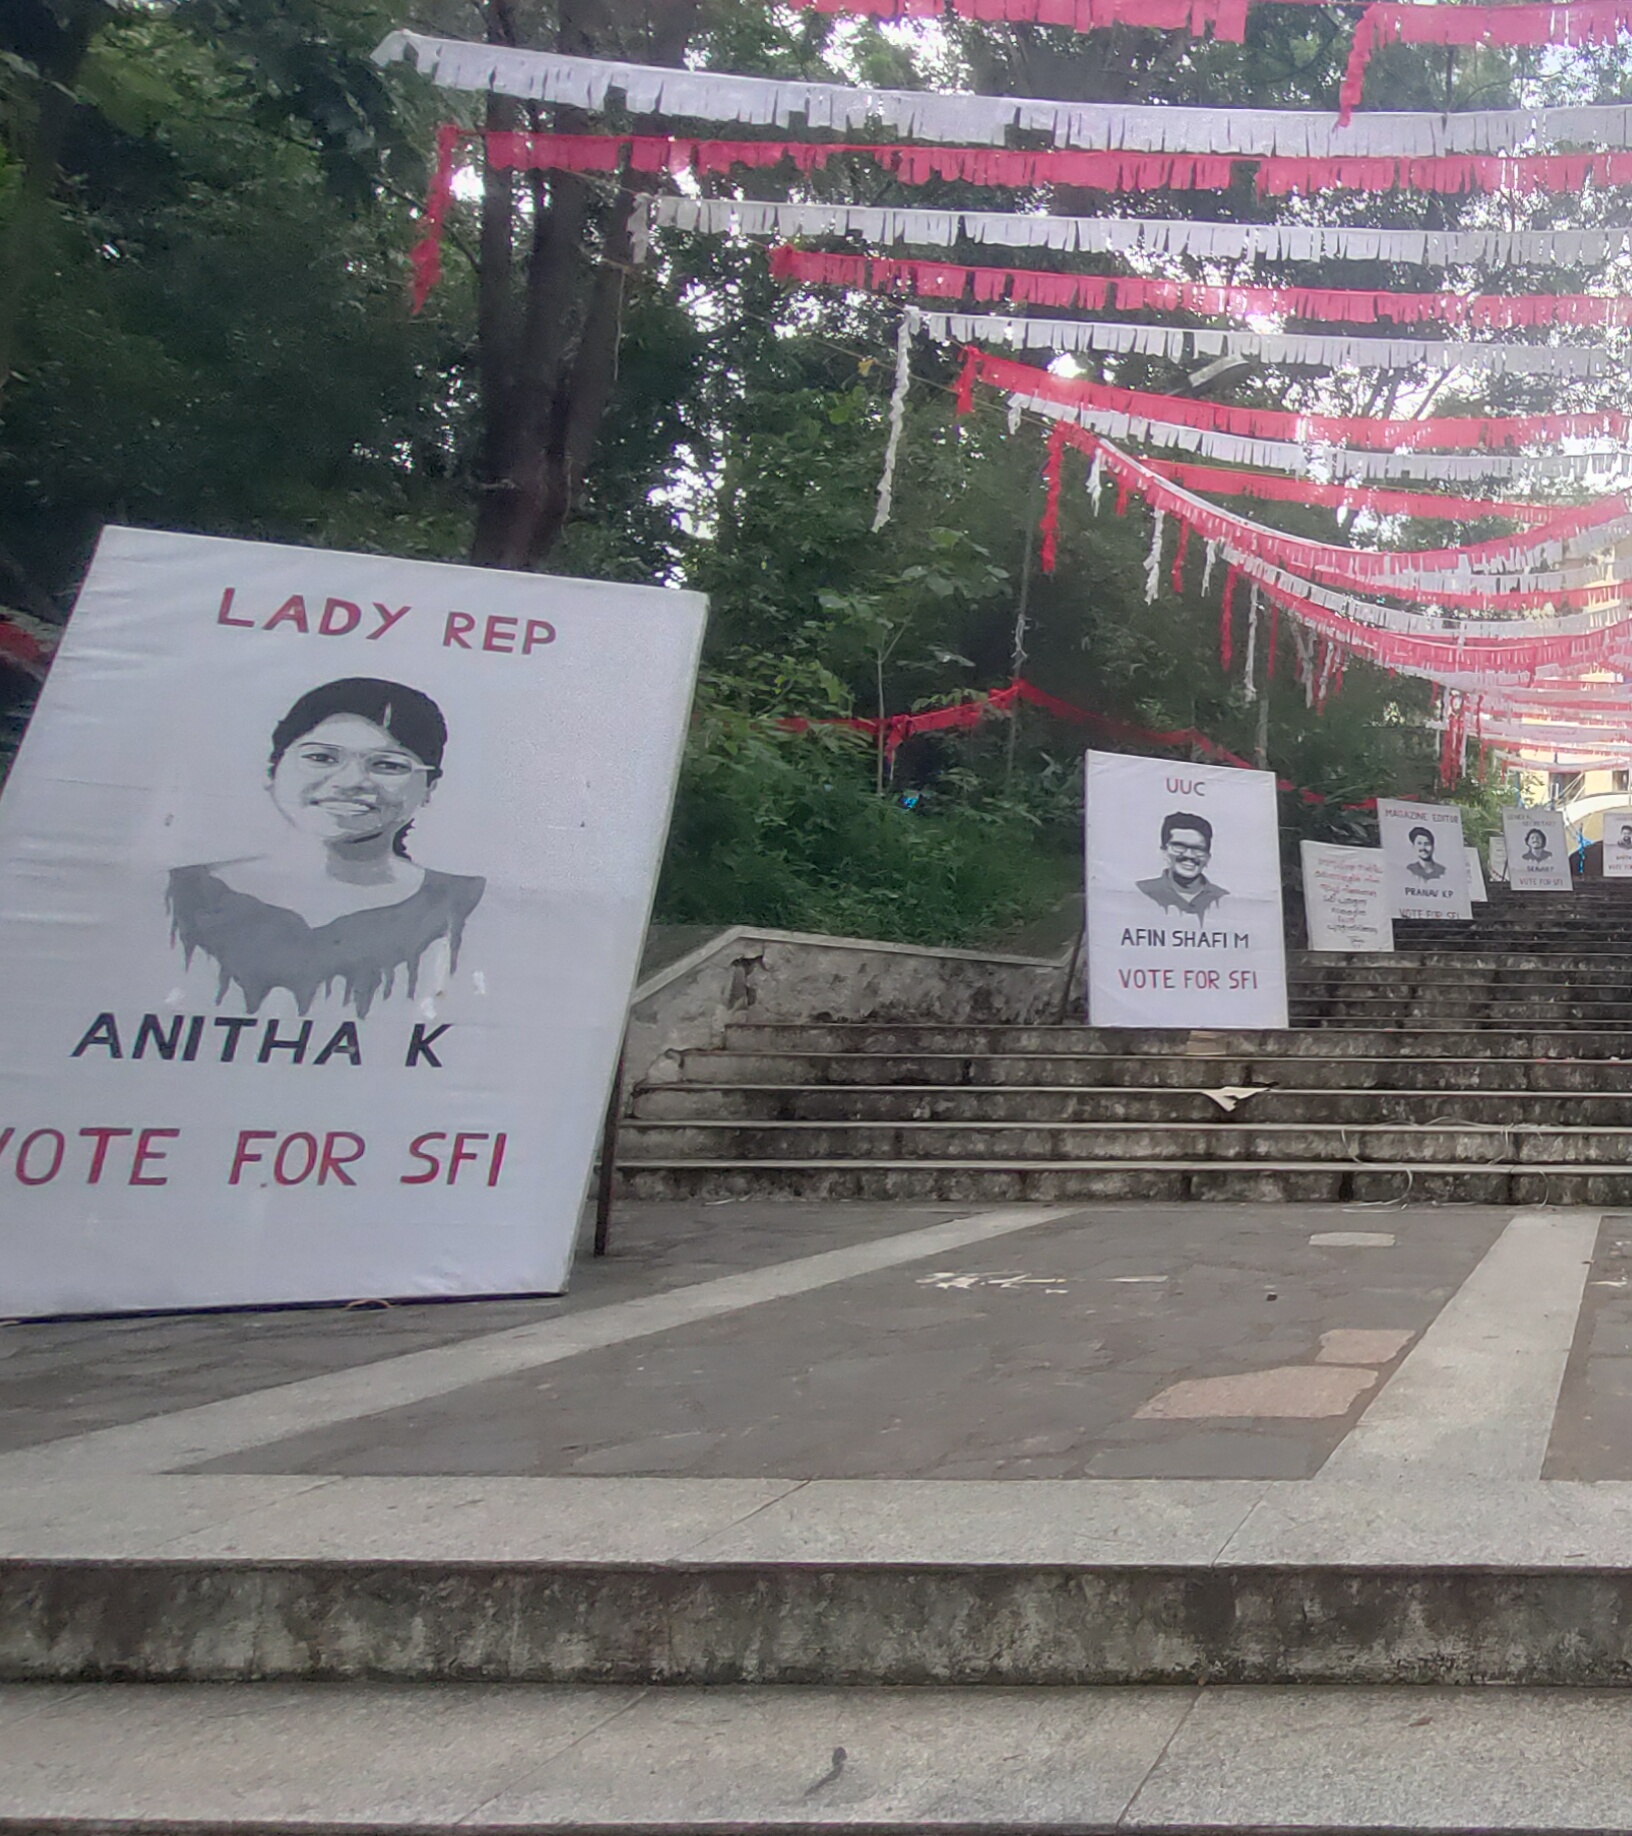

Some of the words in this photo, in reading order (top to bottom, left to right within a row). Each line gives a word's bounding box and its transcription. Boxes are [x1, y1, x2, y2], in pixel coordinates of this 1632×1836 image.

[217, 587, 411, 641] LADY
[442, 611, 557, 655] REP
[1166, 777, 1206, 797] UUC
[1385, 809, 1428, 821] MAGAZINE
[1432, 813, 1459, 824] EDITOR
[1404, 887, 1439, 898] PRANAV
[1399, 908, 1422, 919] VOTE
[1120, 927, 1166, 947] AFIN
[1172, 930, 1228, 949] SHAFI
[1234, 932, 1249, 949] M
[1118, 968, 1175, 989] VOTE
[1184, 969, 1220, 990] FOR
[1228, 970, 1258, 990] SFI
[69, 1012, 363, 1066] ANITHA
[405, 1023, 454, 1068] K
[228, 1130, 366, 1187] FOR
[400, 1132, 507, 1187] SFI
